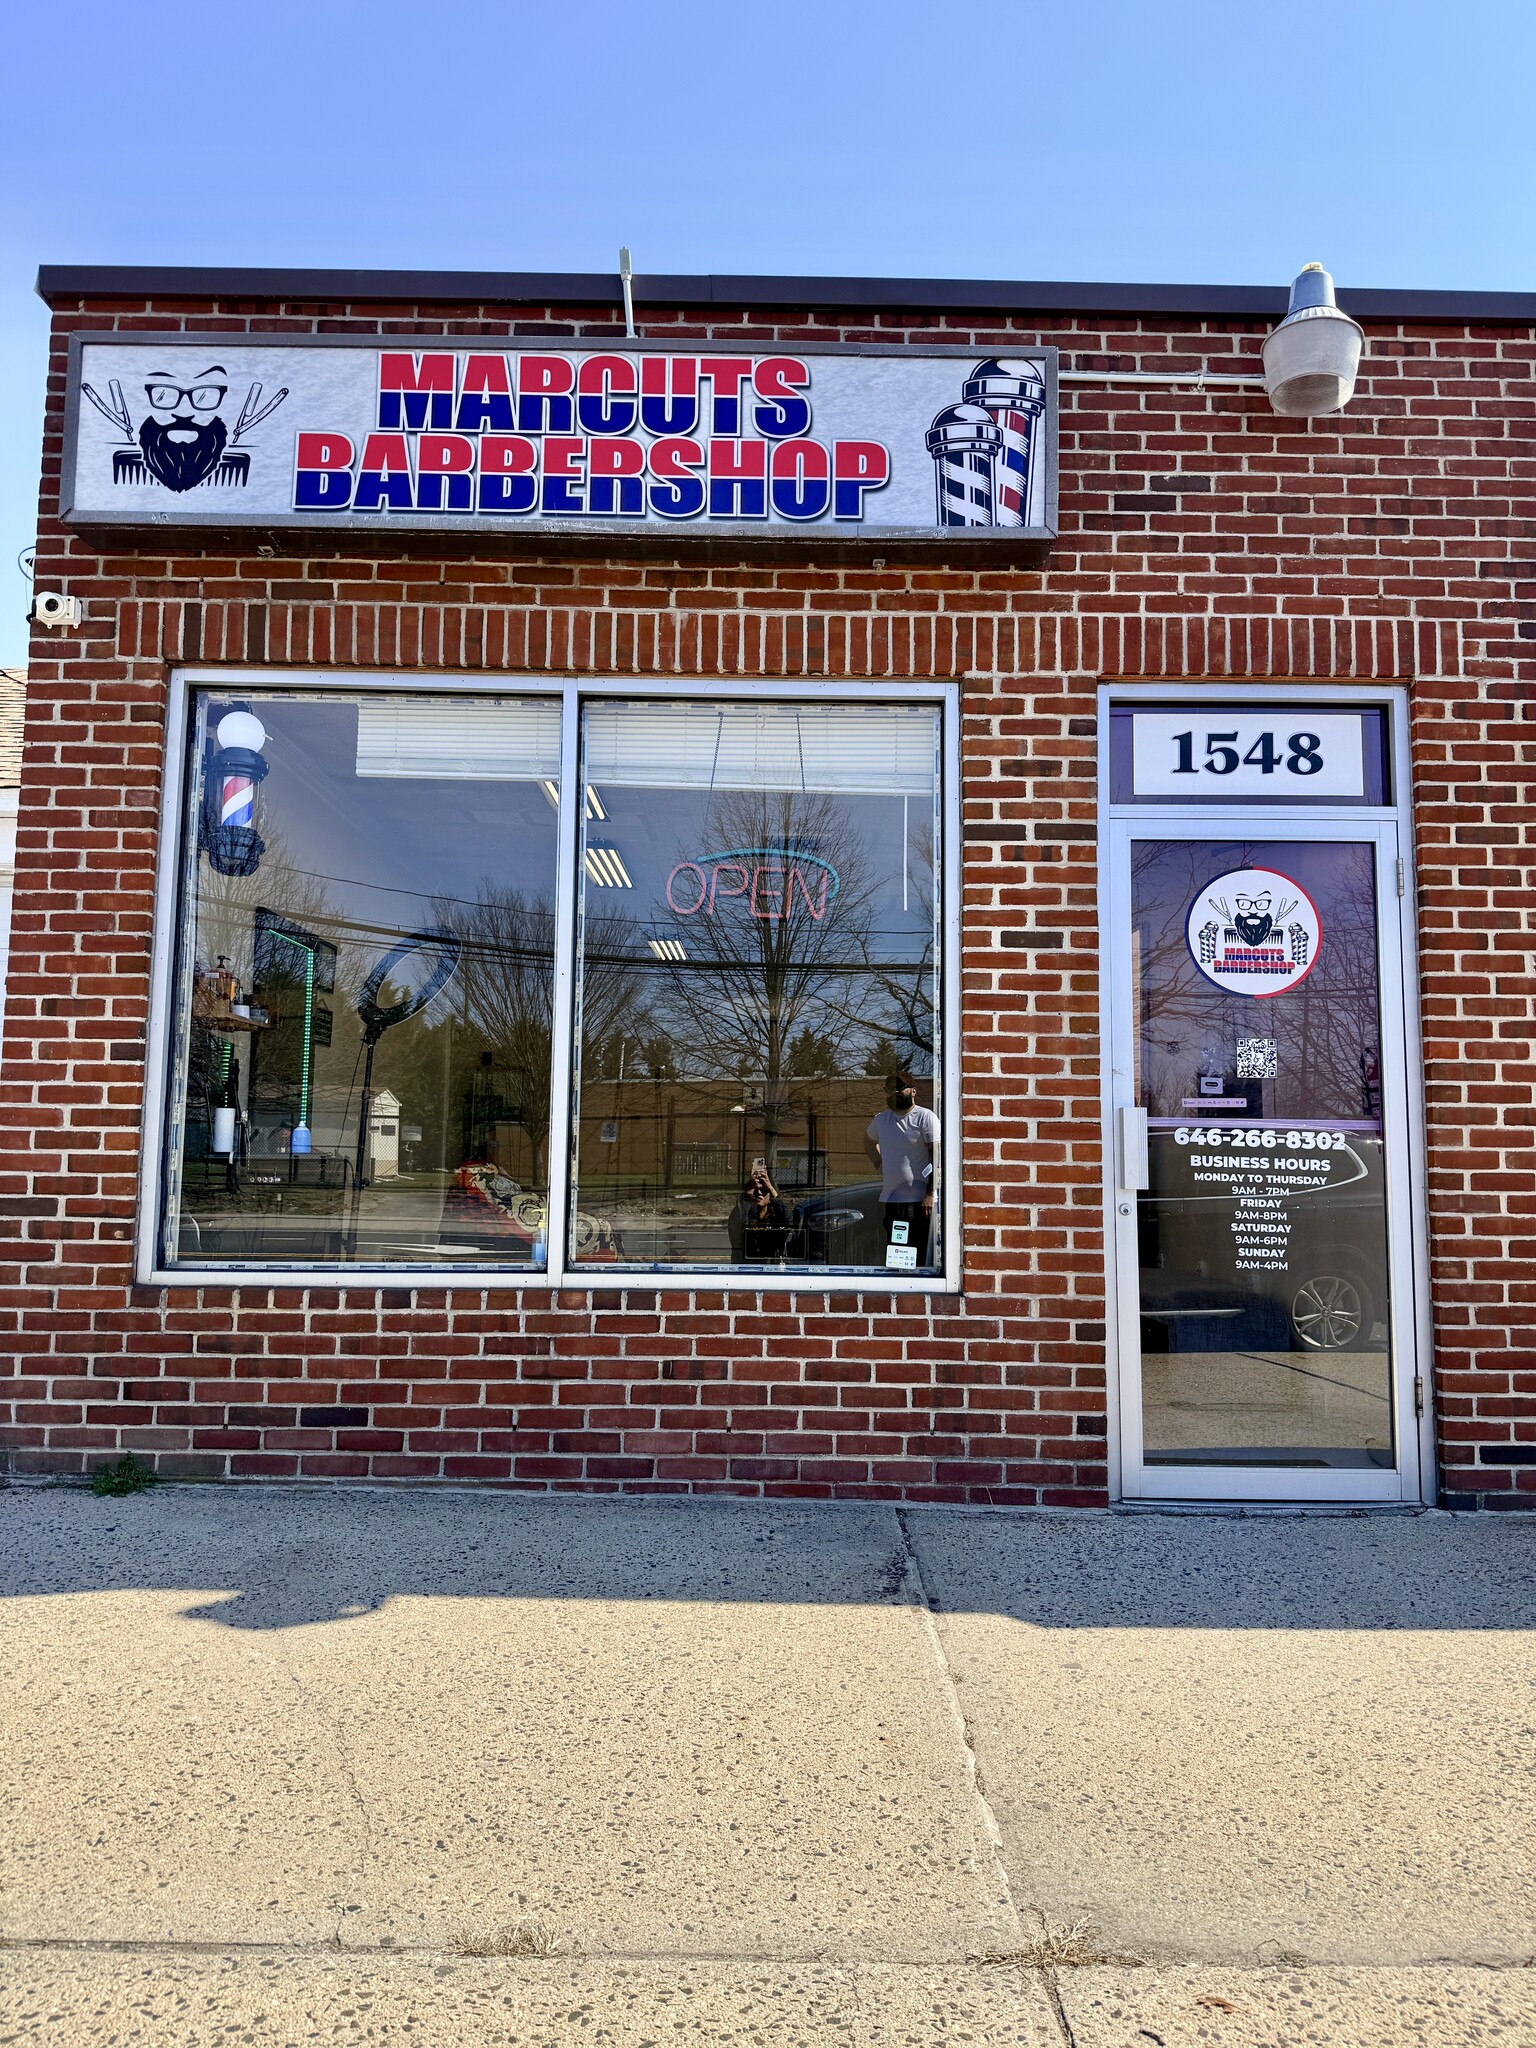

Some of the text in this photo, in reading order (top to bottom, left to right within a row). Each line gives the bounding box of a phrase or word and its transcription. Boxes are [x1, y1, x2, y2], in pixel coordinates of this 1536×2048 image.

[377, 351, 811, 438] MARCUTS
[293, 430, 890, 519] BARBERSHOP
[1171, 731, 1324, 775] 1548
[666, 863, 828, 920] OPEN
[1224, 948, 1285, 961] MARCUTS
[1213, 960, 1295, 974] BARBERSHOP
[1174, 1127, 1346, 1150] 646-266-8302
[1190, 1155, 1331, 1171] BUSINESS HOURS
[1194, 1172, 1327, 1185] MONDAY TO THURSDAY
[1231, 1186, 1256, 1195] 9AM
[1265, 1187, 1290, 1196] 7PM
[1240, 1199, 1282, 1208] FRIDAY
[1234, 1211, 1287, 1221] 9AM-8PM
[1231, 1222, 1292, 1233] SATURDAY
[1235, 1236, 1288, 1245] 9AM-6PM
[1238, 1248, 1286, 1257] SUNDAY
[1235, 1260, 1288, 1270] 9AM-4PM
